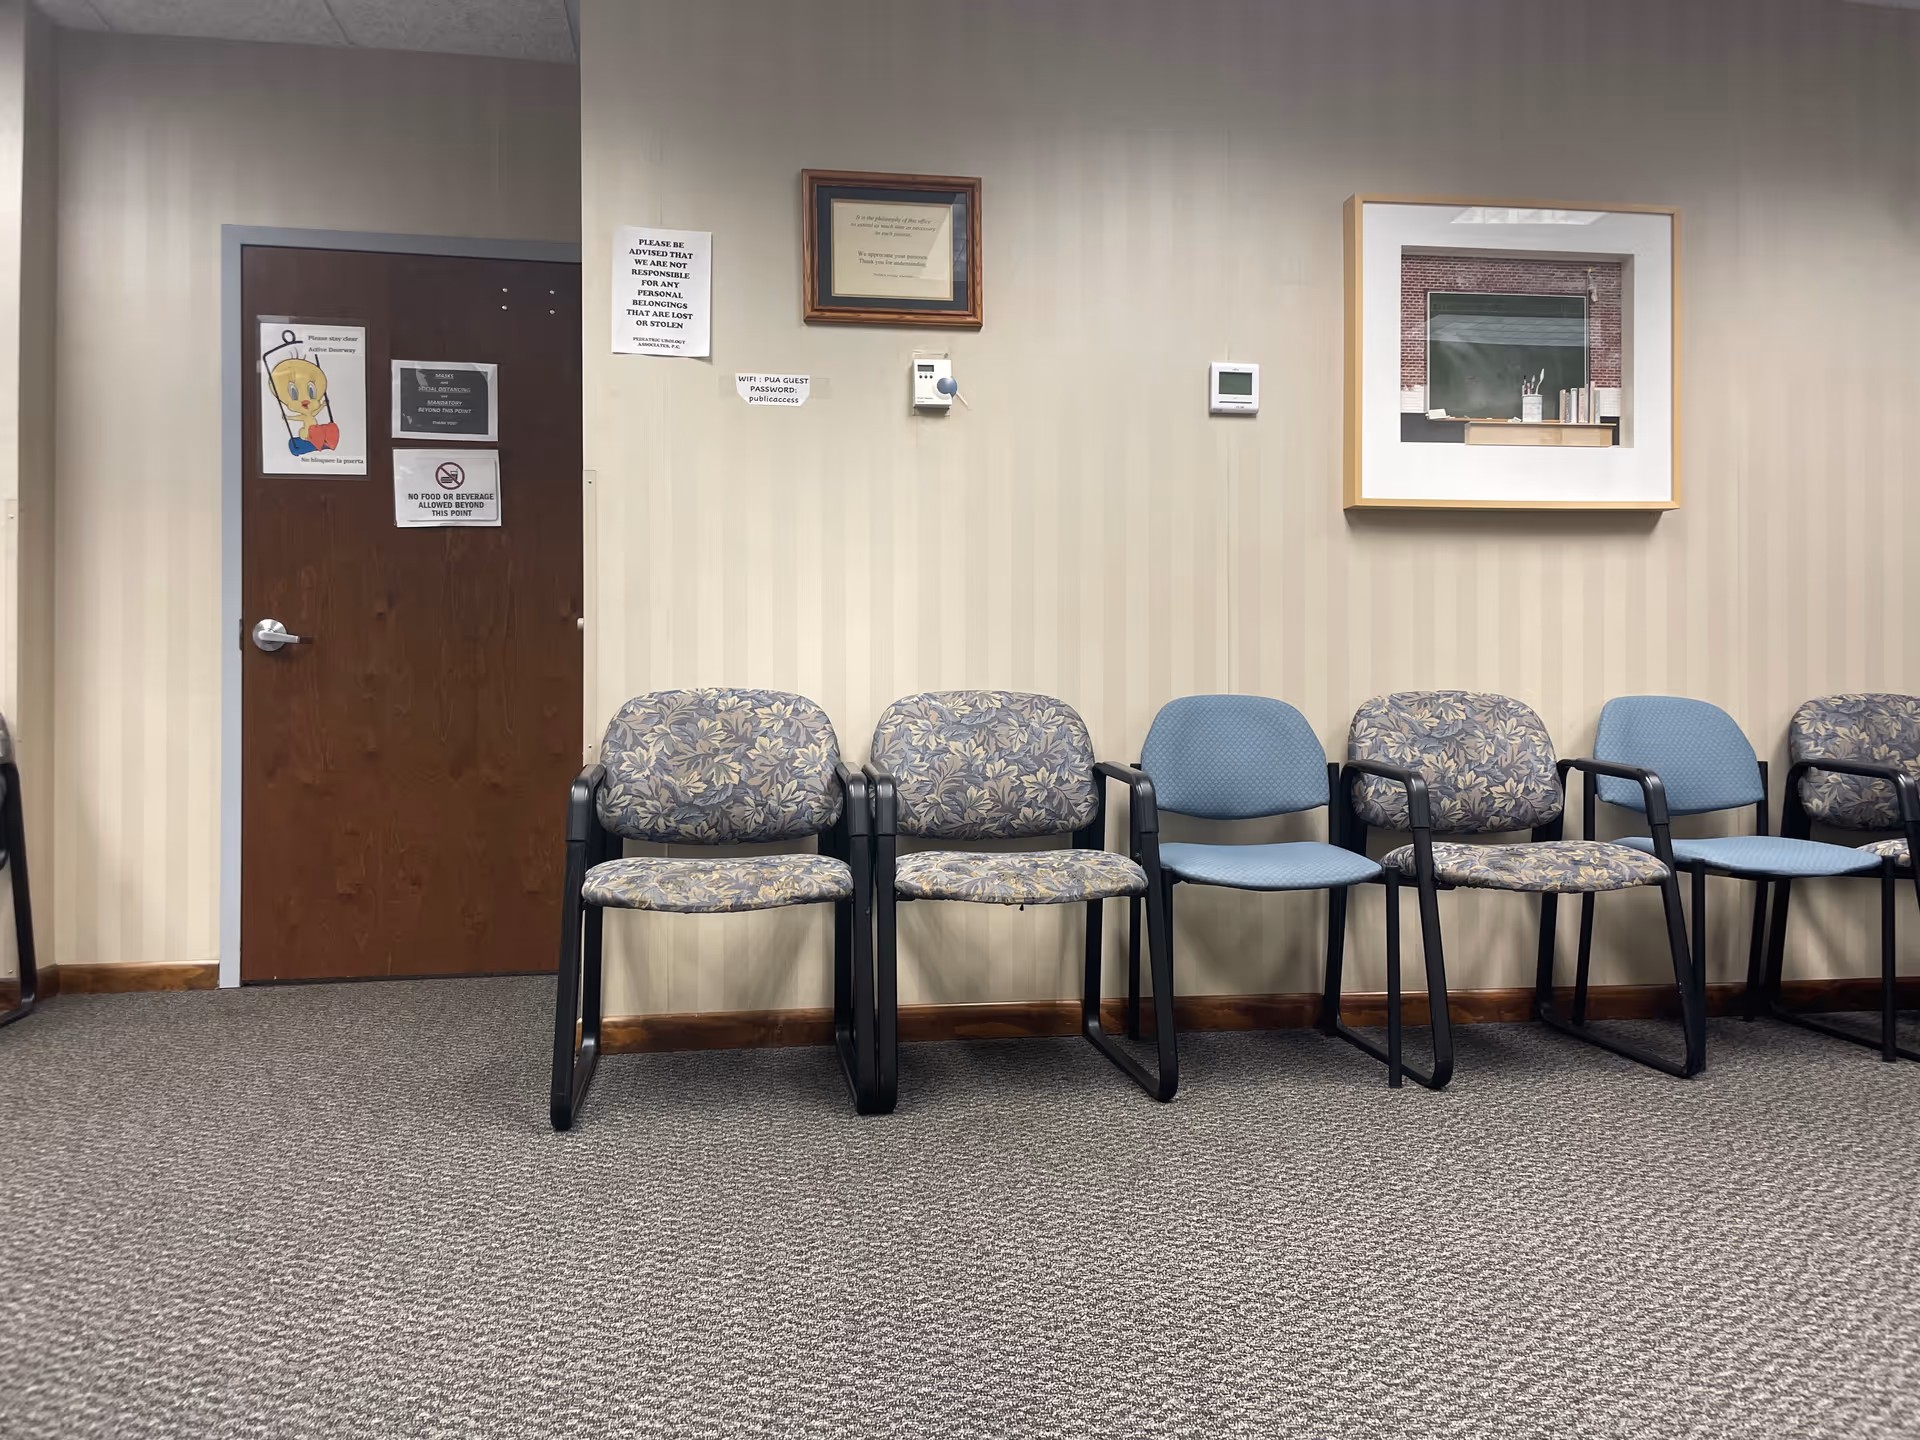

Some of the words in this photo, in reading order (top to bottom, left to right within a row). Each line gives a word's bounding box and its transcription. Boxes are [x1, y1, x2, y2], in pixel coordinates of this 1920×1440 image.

[638, 238, 671, 248] PLEASE
[629, 248, 668, 257] ADVISED
[670, 251, 693, 260] THAT
[631, 269, 690, 279] RESPONSIBLE
[637, 289, 683, 299] PERSONAL
[632, 299, 688, 309] BELONGINGS
[672, 312, 693, 320] LOST
[650, 320, 683, 329] STOLEN
[749, 395, 799, 403] publicaccess
